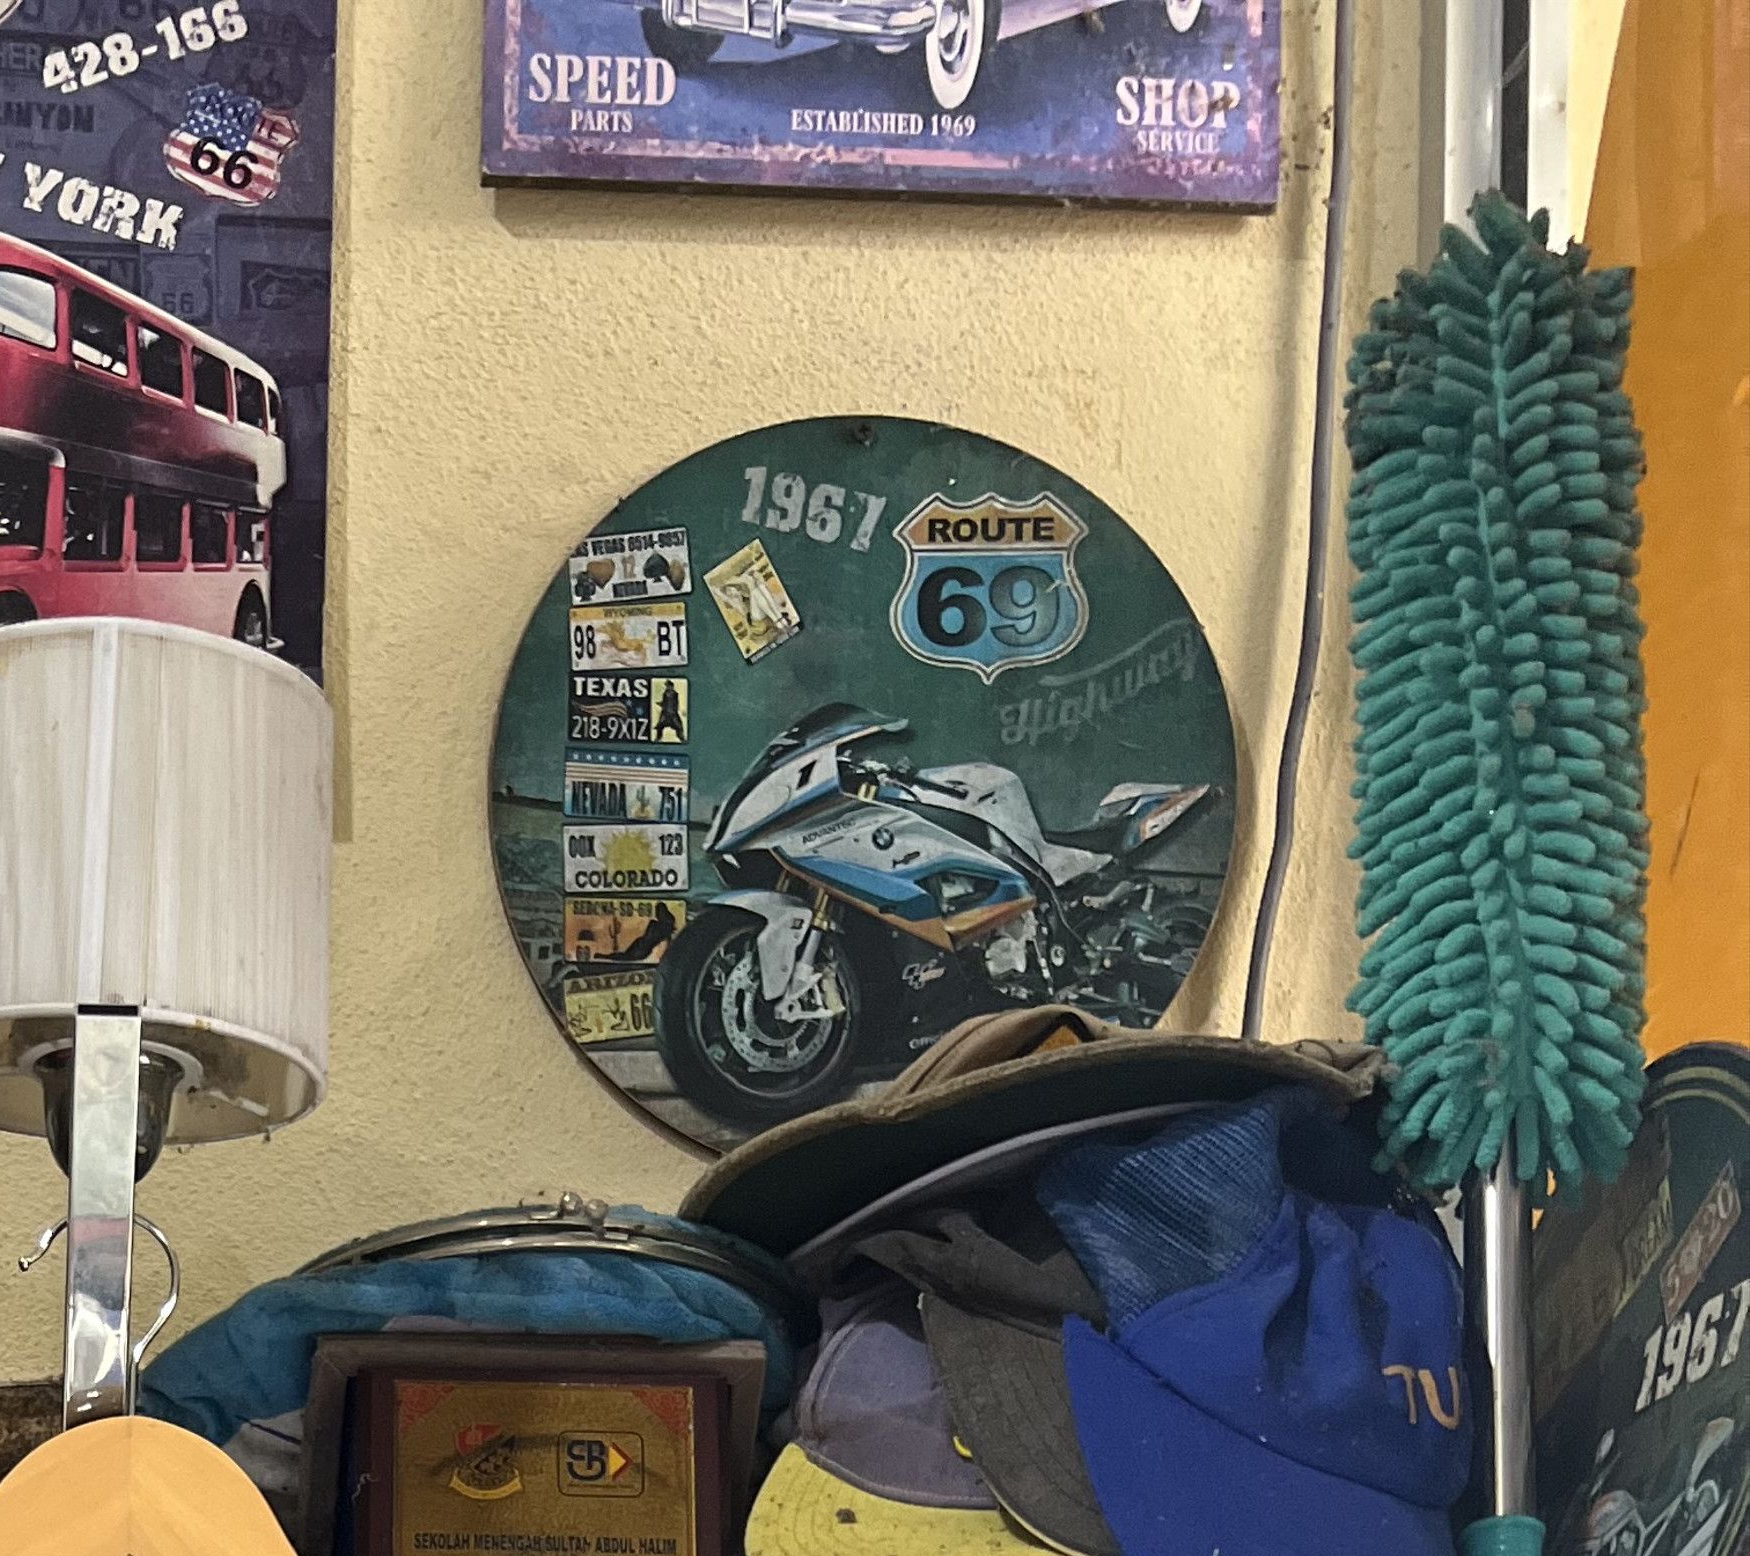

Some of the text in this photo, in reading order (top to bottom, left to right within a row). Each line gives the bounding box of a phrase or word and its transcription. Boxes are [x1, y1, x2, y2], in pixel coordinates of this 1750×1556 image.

[43, 0, 248, 94] 428-166
[528, 53, 676, 106] SPEED
[570, 108, 633, 133] PARTS
[1115, 74, 1240, 129] SHOP
[790, 107, 976, 137] ESTABLISHED 1969
[1137, 130, 1220, 154] SERVICE
[191, 136, 258, 189] 66
[23, 162, 184, 251] YORK
[742, 466, 887, 553] 1967
[927, 518, 1055, 543] ROUTE
[917, 565, 1060, 648] 69
[574, 620, 684, 660] 98 BT
[574, 676, 648, 698] TEXAS
[571, 780, 683, 821] NEVADA 751
[659, 833, 683, 856] 123
[575, 869, 678, 888] COLORADO
[1635, 1278, 1750, 1413] 1967
[414, 1533, 470, 1550] SEKOLAH
[595, 1537, 635, 1554] ABDUL
[638, 1538, 677, 1556] HALIM
